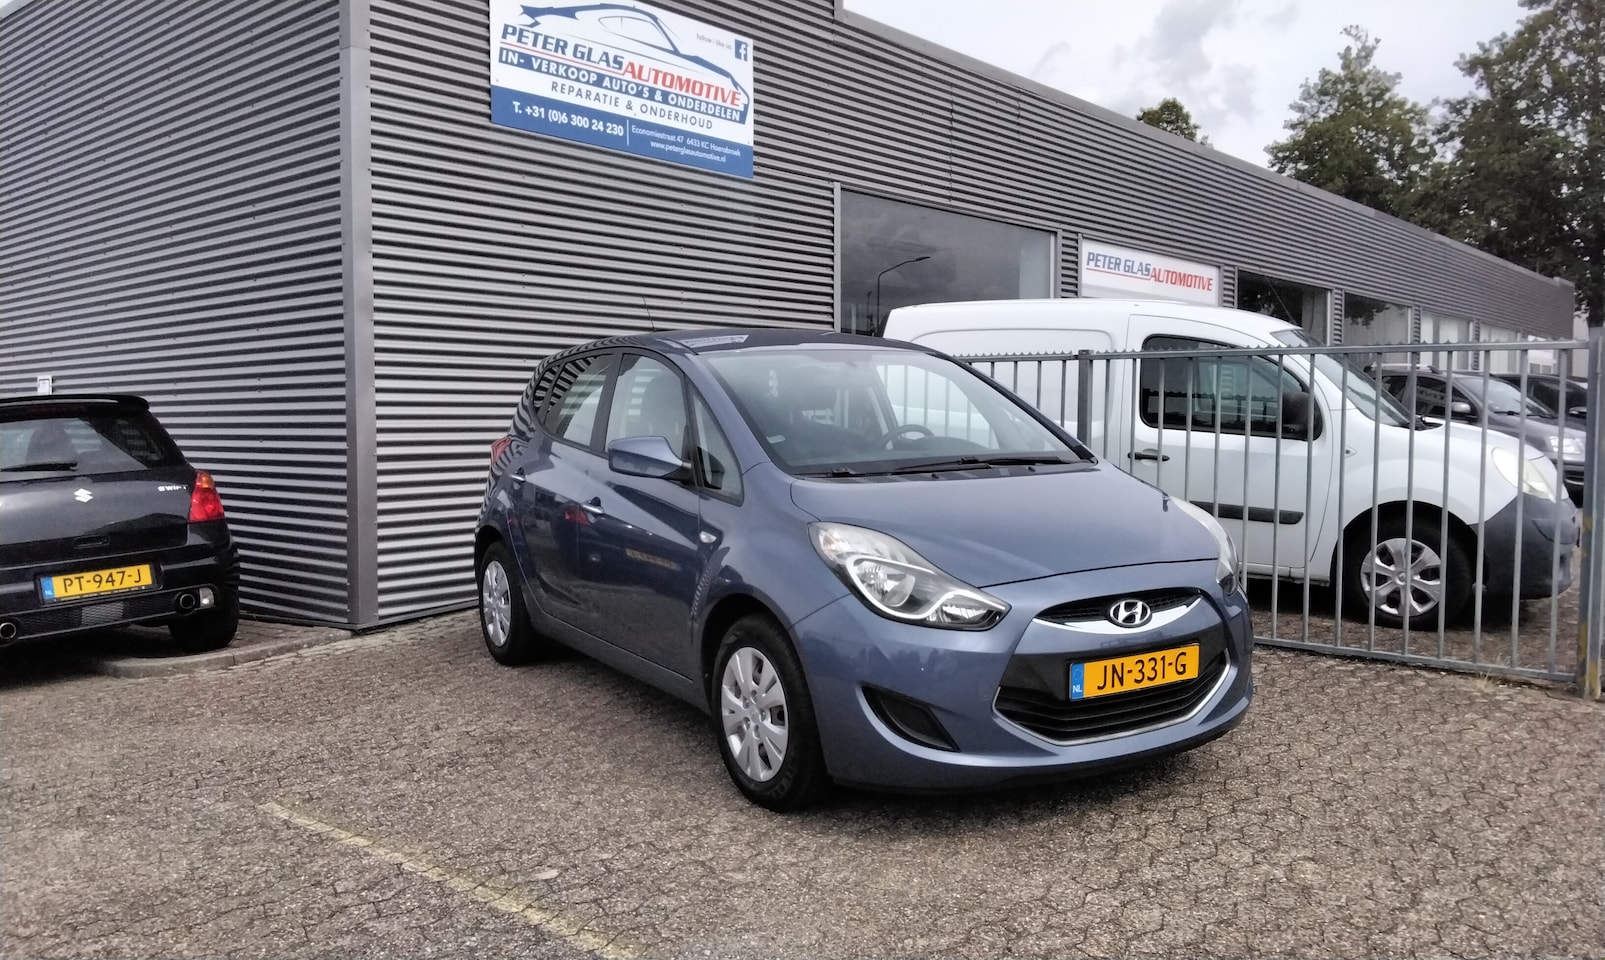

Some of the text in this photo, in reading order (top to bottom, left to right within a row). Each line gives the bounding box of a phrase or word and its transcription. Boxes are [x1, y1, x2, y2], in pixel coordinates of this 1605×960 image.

[501, 23, 568, 56] PETER
[501, 49, 740, 121] IN- VERKOOP AUTO'S & ONDERDELEN
[512, 101, 624, 136] T. +31 (0)6 300 24 230
[551, 81, 713, 129] REPARATIE & ONDERHOUD
[631, 125, 676, 142] Economiestraat
[686, 137, 700, 147] 6433
[701, 140, 709, 150] KC
[650, 141, 726, 162] www.peterglasautomotive.nl
[1086, 252, 1121, 272] PETER
[63, 569, 142, 592] PT-947-J
[1072, 651, 1187, 693] NL JN-331-G
